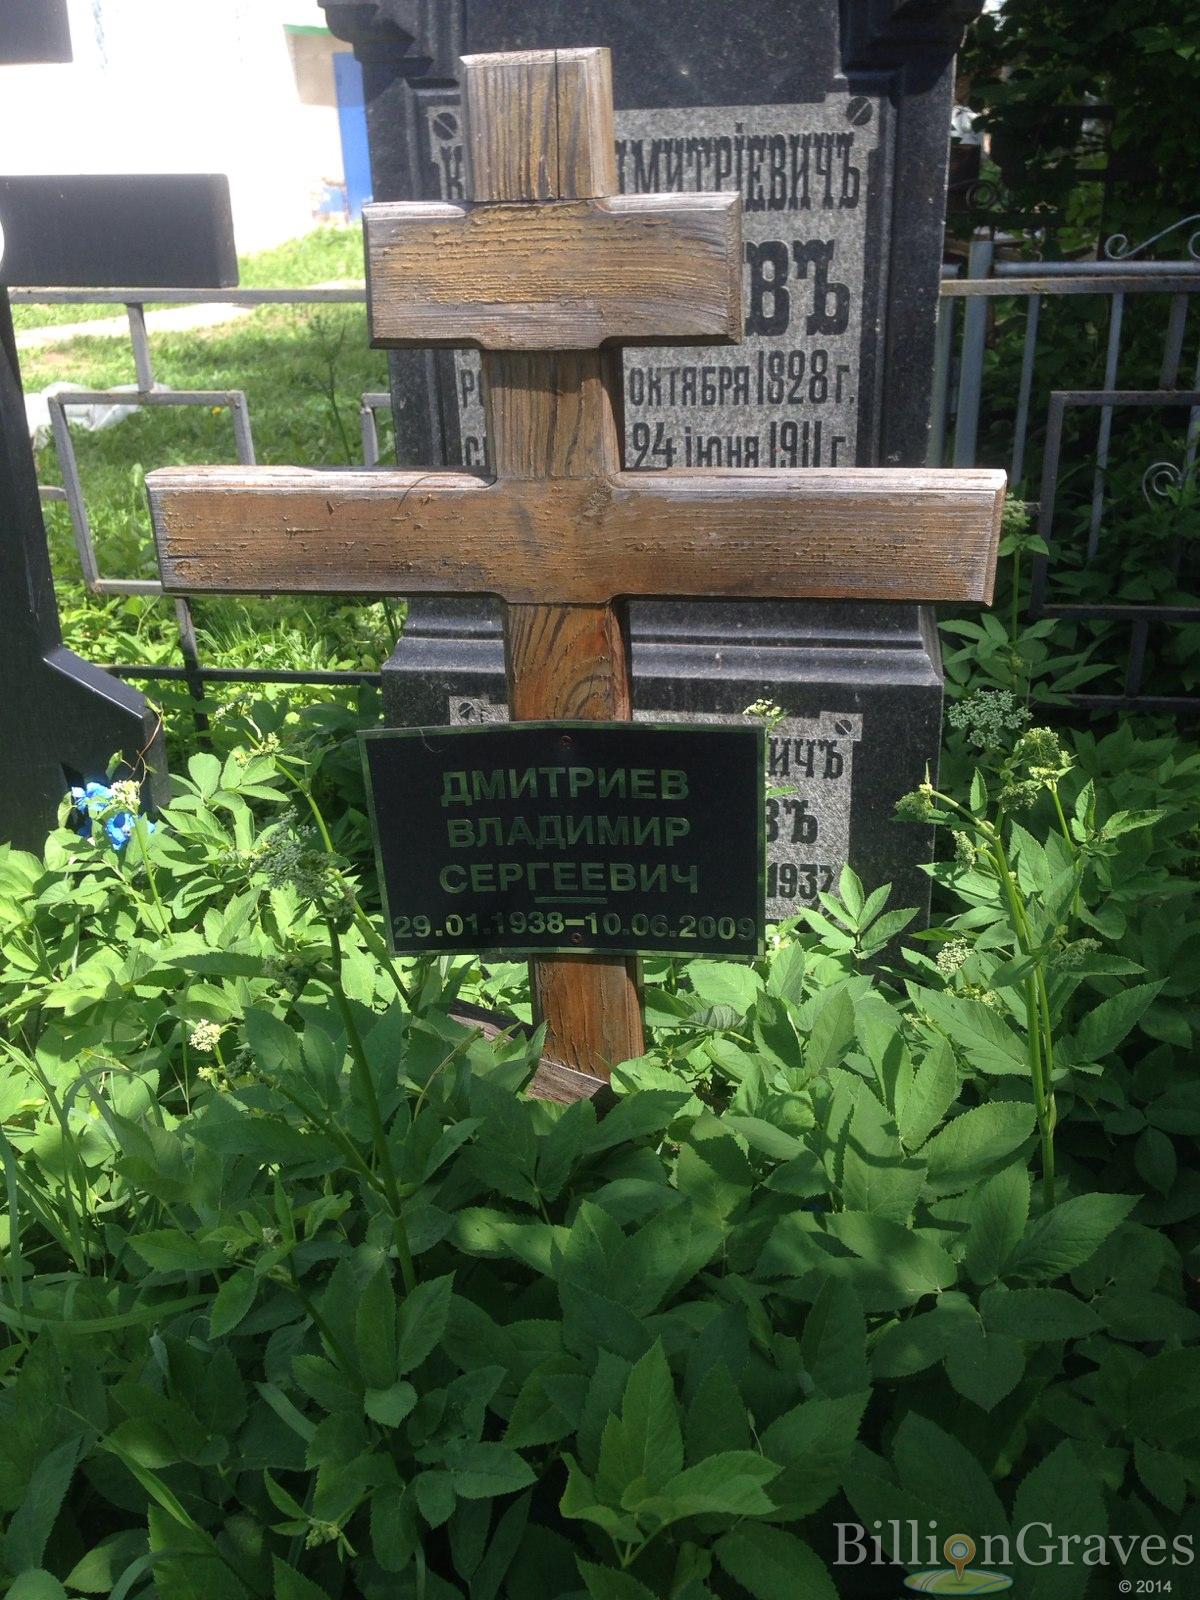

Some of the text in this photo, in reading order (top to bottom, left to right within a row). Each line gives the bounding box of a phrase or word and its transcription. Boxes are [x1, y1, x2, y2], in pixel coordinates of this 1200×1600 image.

[757, 350, 829, 405] 1828
[770, 421, 823, 467] 1911
[440, 767, 690, 808] ДМИТРИЕВ
[447, 815, 692, 850] ВЛАДИМИР
[439, 862, 699, 894] СЕРГЕЕВИЧ
